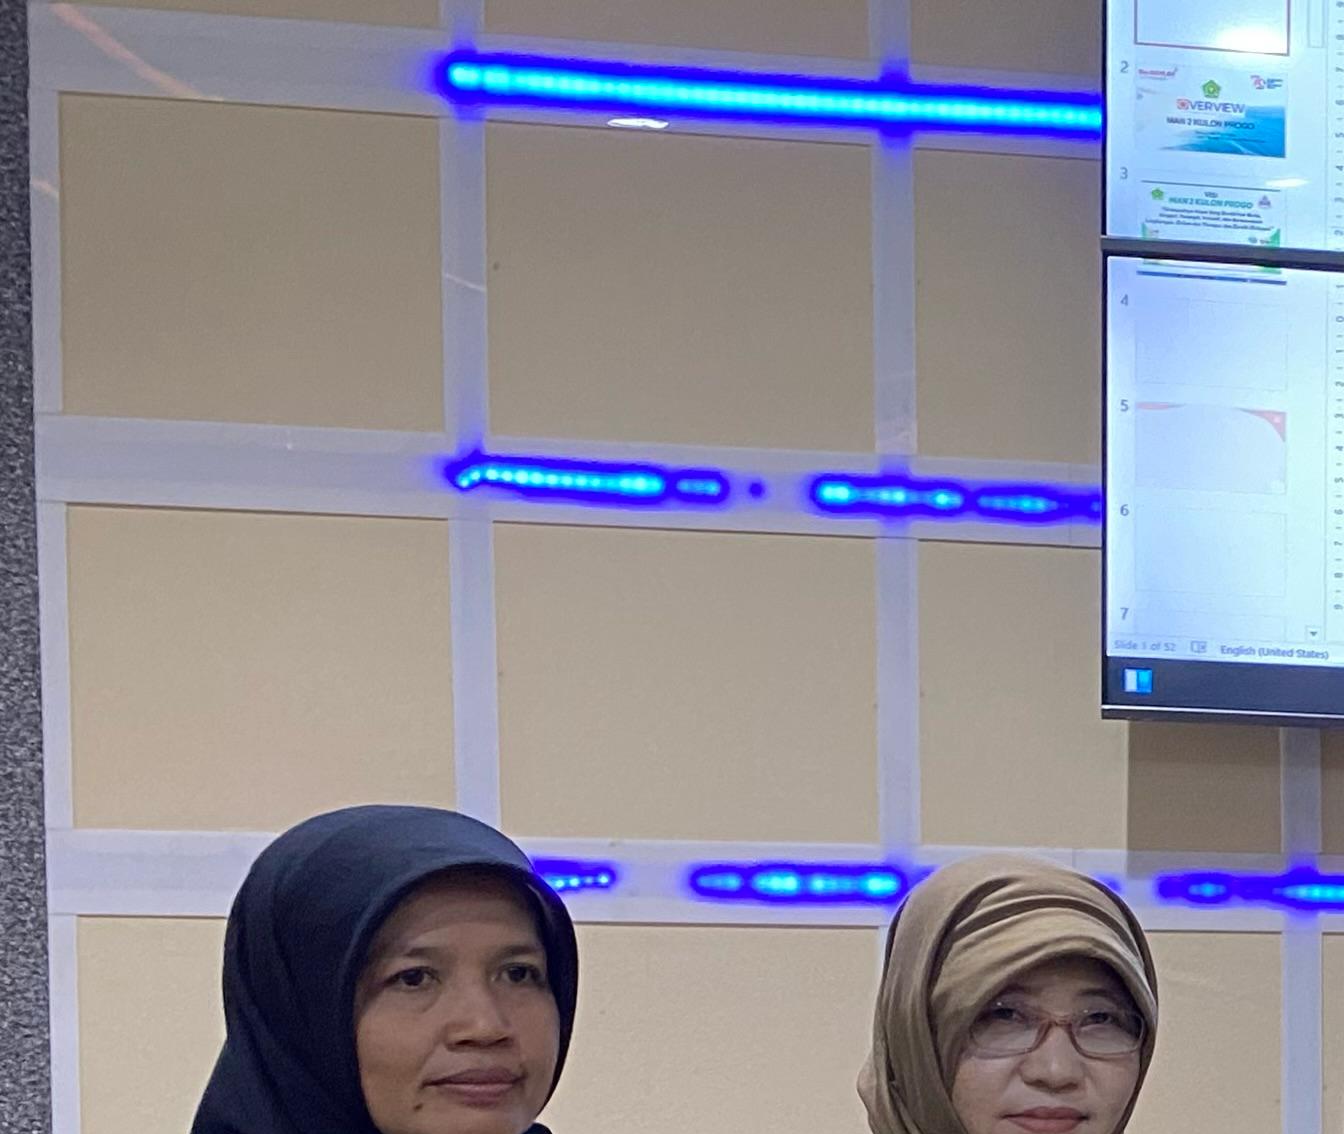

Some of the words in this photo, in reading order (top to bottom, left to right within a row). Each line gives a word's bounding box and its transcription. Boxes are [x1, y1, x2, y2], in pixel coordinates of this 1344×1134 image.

[1120, 60, 1129, 73] 2
[1120, 167, 1129, 180] 3
[1120, 294, 1129, 306] 4
[1120, 399, 1129, 412] 5
[1120, 504, 1129, 517] 6
[1120, 608, 1129, 621] 7
[1114, 639, 1137, 650] Slide
[1151, 641, 1161, 651] of
[1220, 645, 1256, 657] English
[1259, 647, 1294, 658] (United
[1296, 649, 1329, 660] States)
